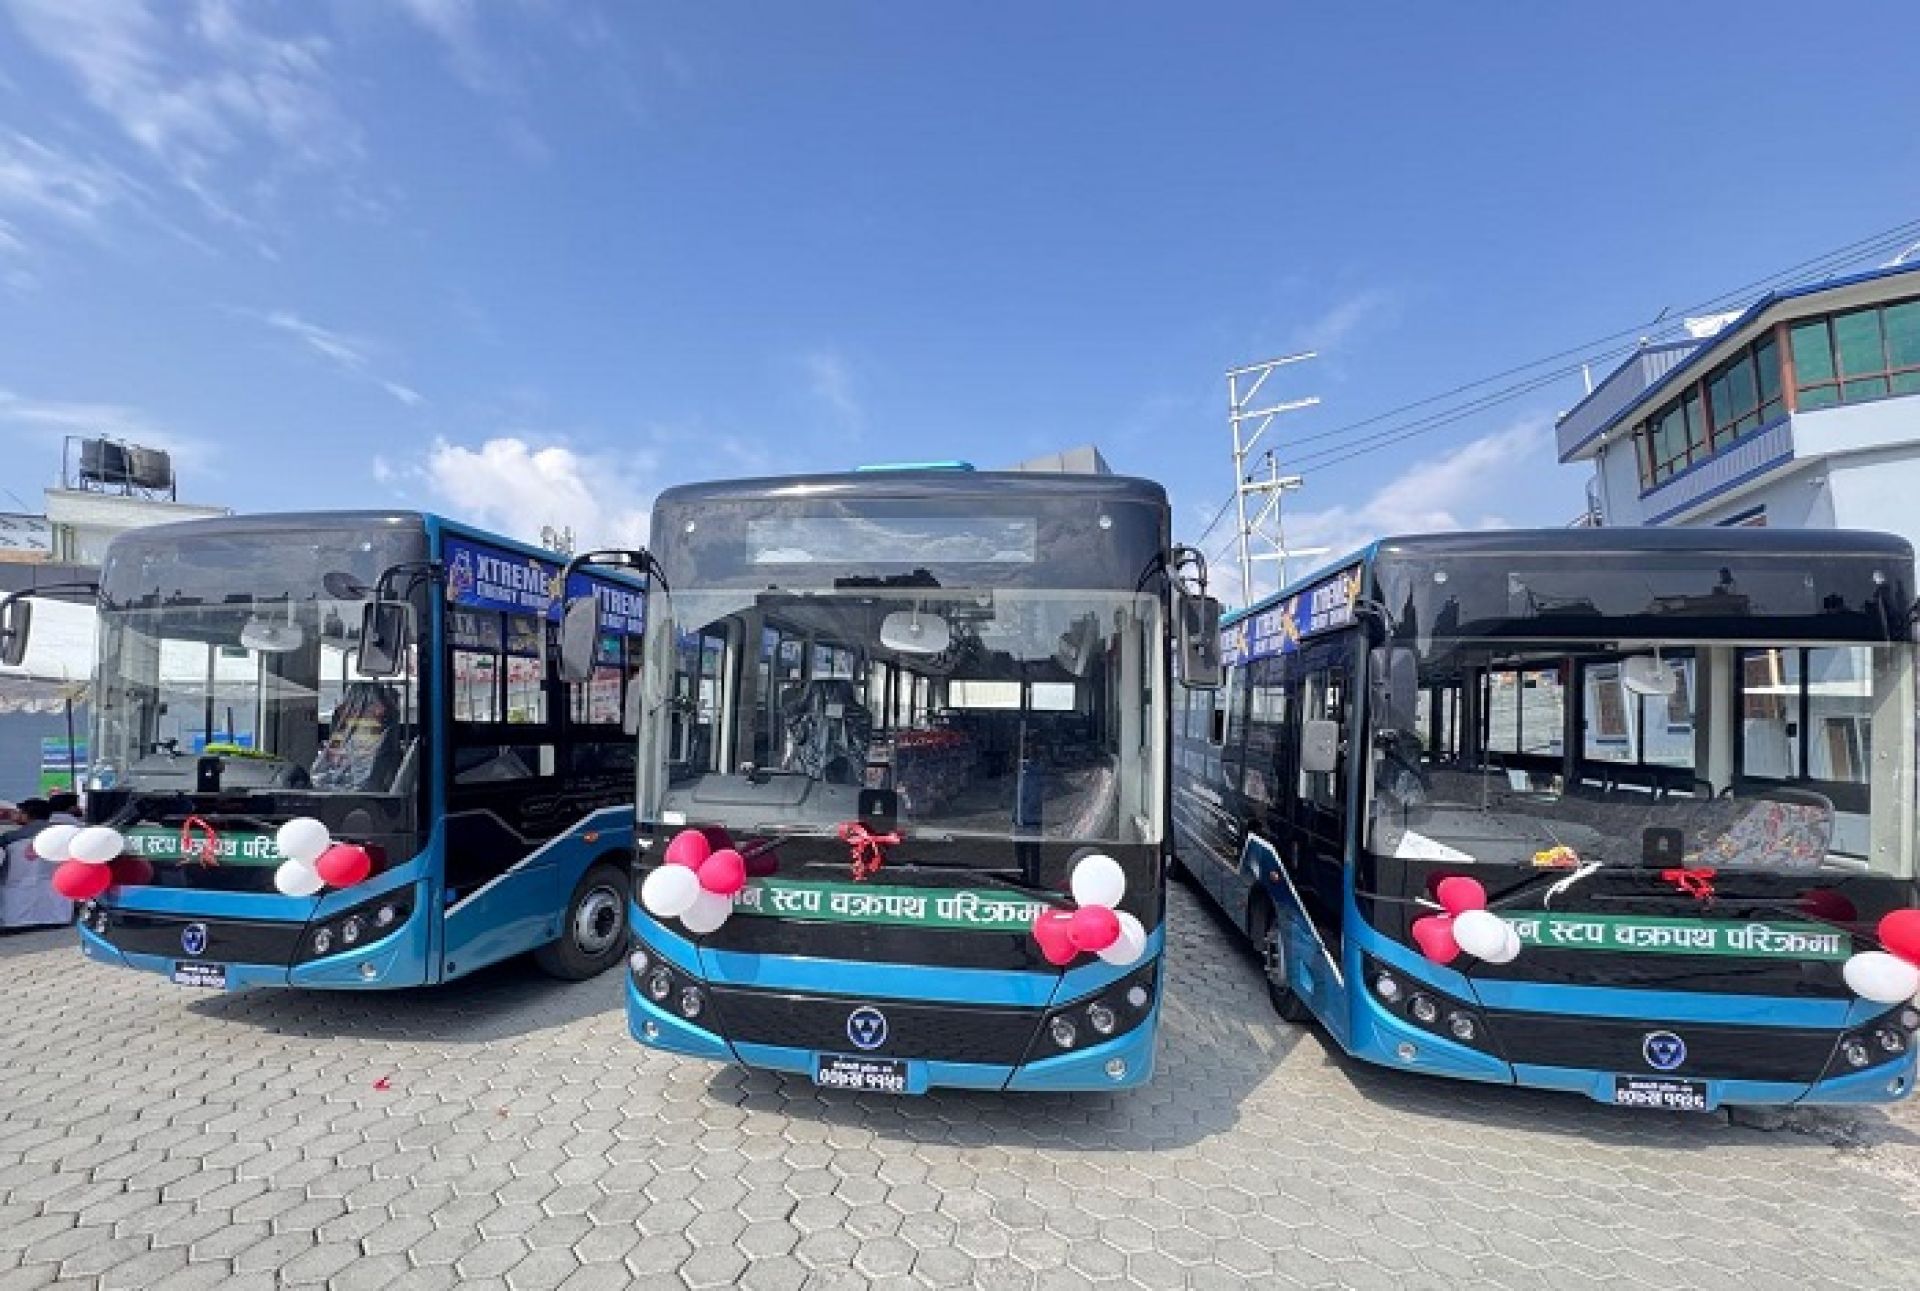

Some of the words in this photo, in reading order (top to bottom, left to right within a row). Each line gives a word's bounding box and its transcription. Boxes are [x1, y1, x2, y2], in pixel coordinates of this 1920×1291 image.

[477, 554, 549, 596] XTREME
[770, 887, 823, 913] स्टप
[830, 893, 928, 920] चक्रपथ
[1549, 919, 1605, 944] स्टप
[1614, 923, 1717, 948] चक्रपथ
[1725, 922, 1841, 954] परिक्रमा
